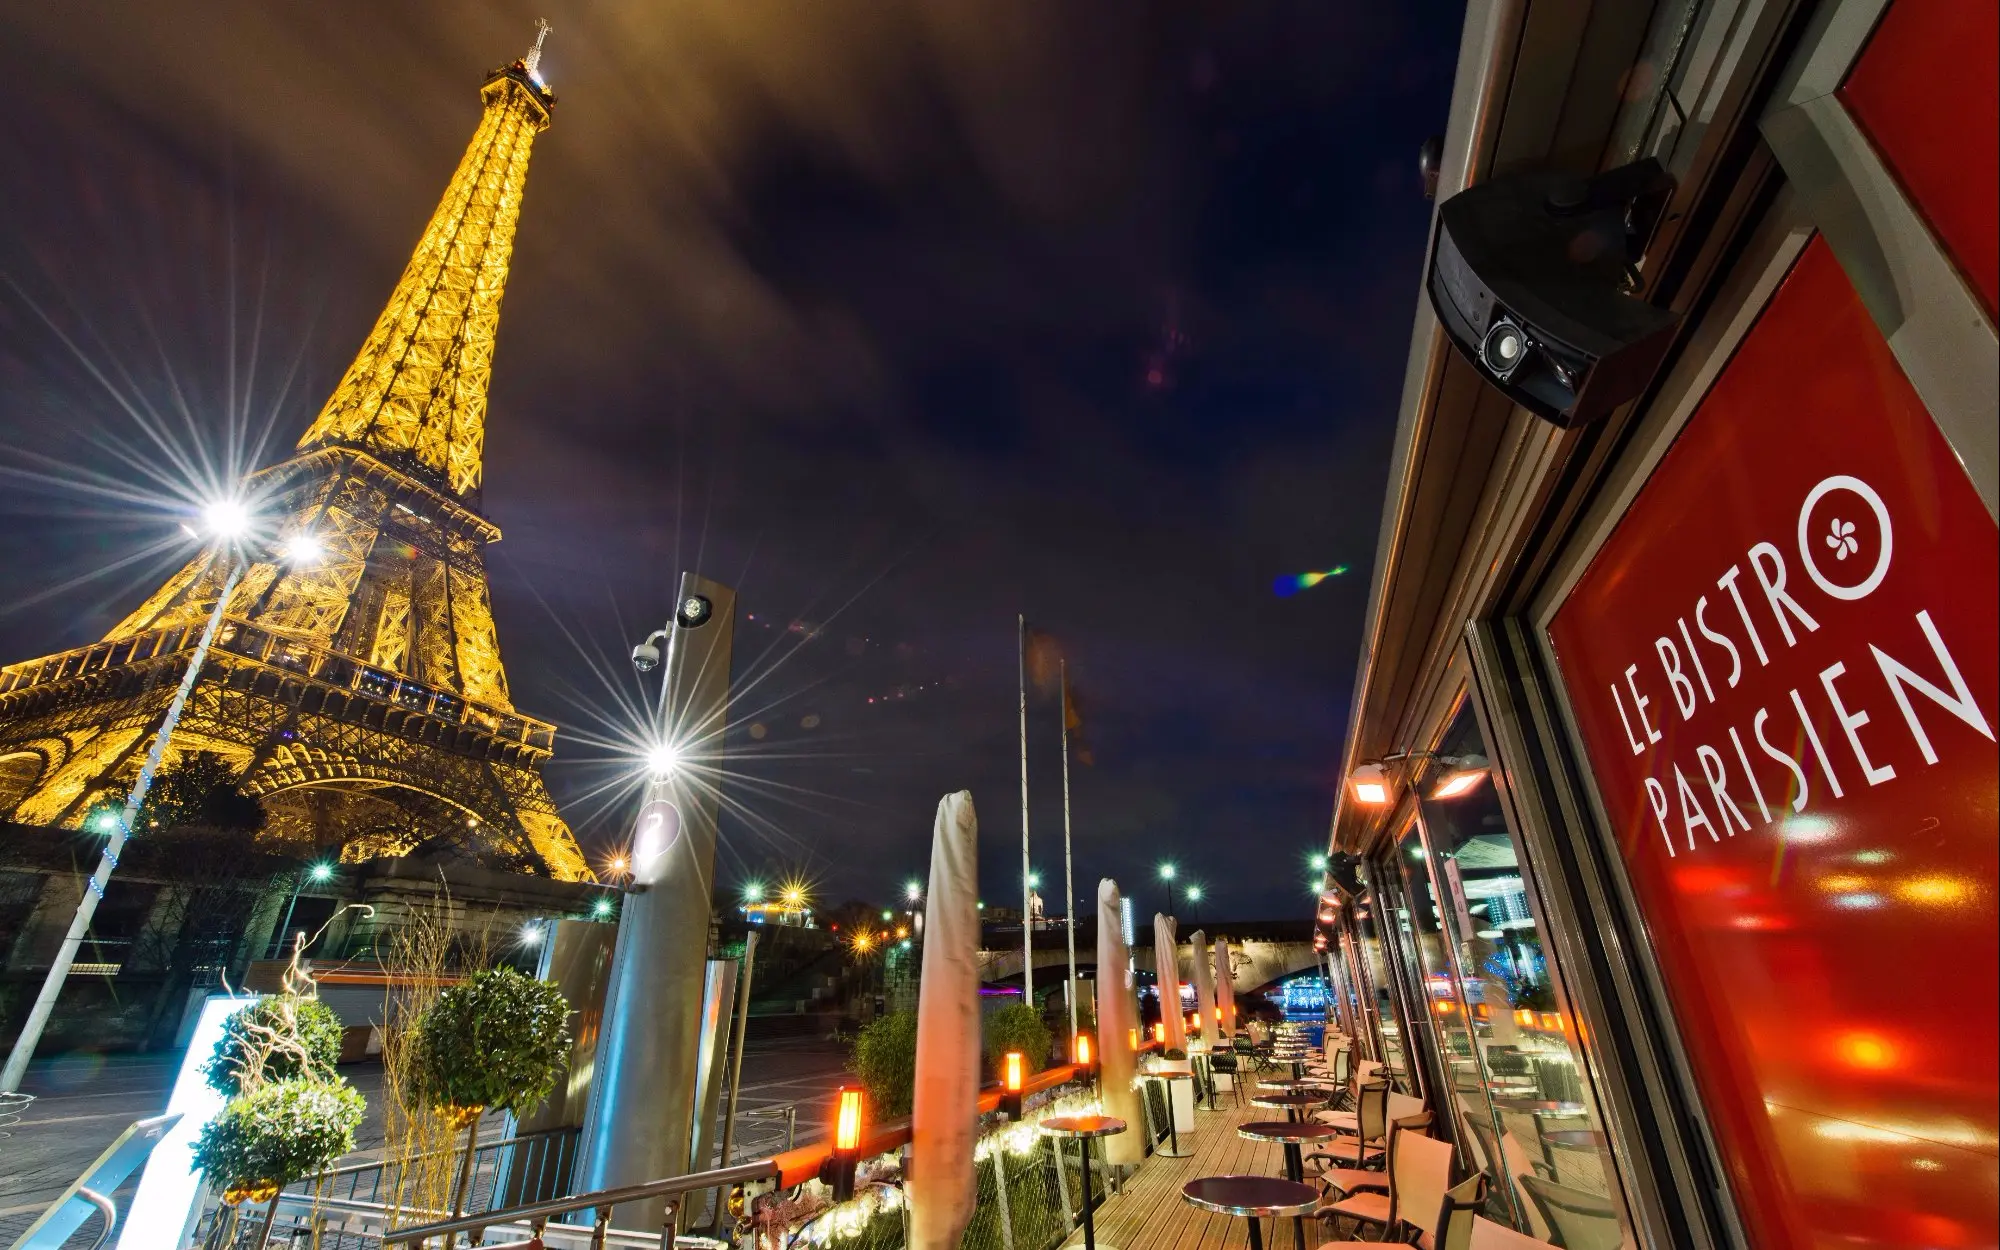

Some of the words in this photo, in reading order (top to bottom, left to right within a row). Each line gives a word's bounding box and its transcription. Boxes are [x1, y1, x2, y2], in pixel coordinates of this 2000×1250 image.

[1610, 663, 1663, 756] LE
[1654, 475, 1893, 721] BISTRO
[1643, 609, 1997, 858] PARISIEN
